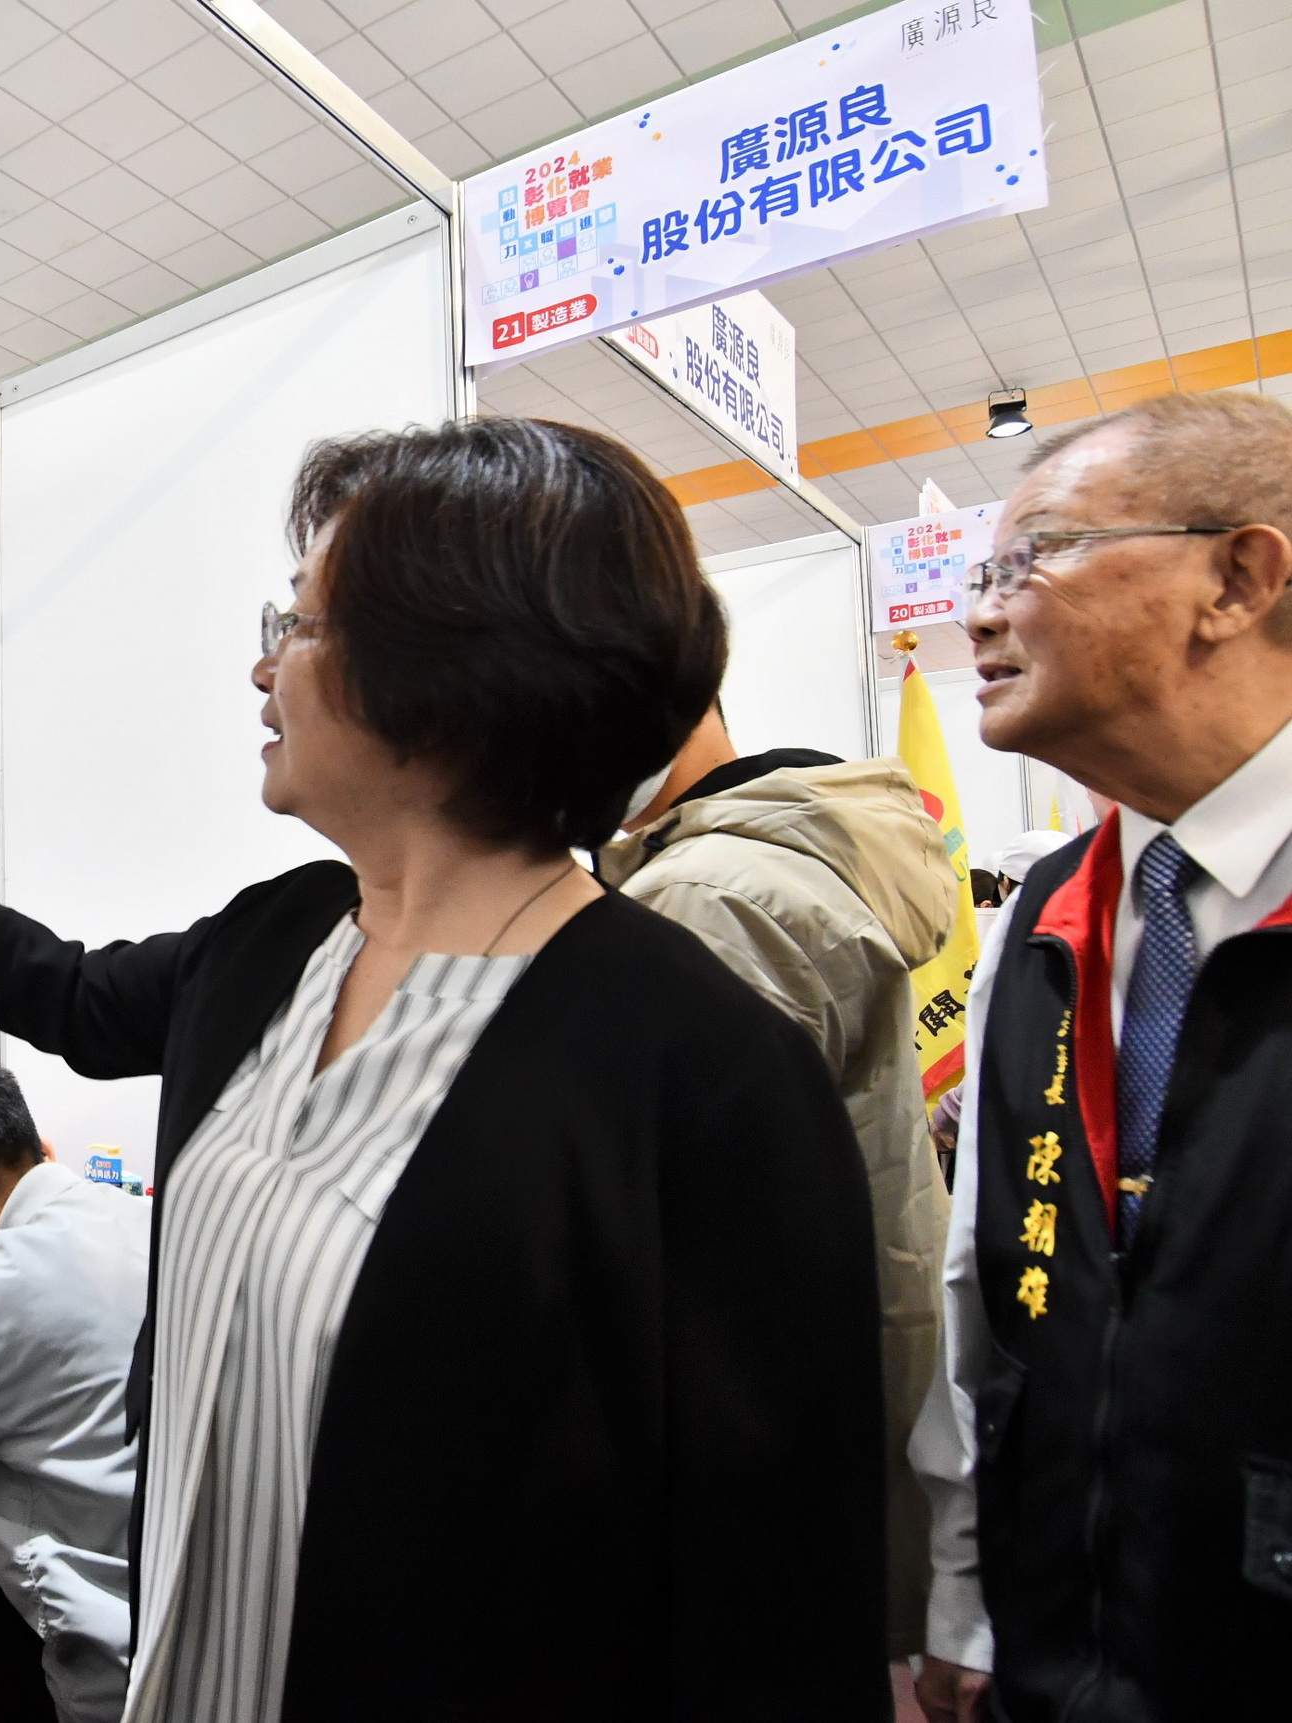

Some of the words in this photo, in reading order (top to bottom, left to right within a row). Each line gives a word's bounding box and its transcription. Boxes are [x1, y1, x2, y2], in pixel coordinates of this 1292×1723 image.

[900, 0, 999, 53] 廣源良
[718, 82, 893, 184] 廣源良
[524, 150, 581, 185] 2024
[524, 156, 613, 207] 彰化就業
[641, 103, 994, 265] 股份有限公司
[525, 189, 590, 230] 博覽會
[496, 319, 523, 344] 21
[531, 298, 589, 333] 製造業
[712, 303, 761, 389] 廣源良
[685, 335, 785, 461] 股份有限公司
[907, 522, 943, 537] 2024
[891, 607, 908, 620] 20
